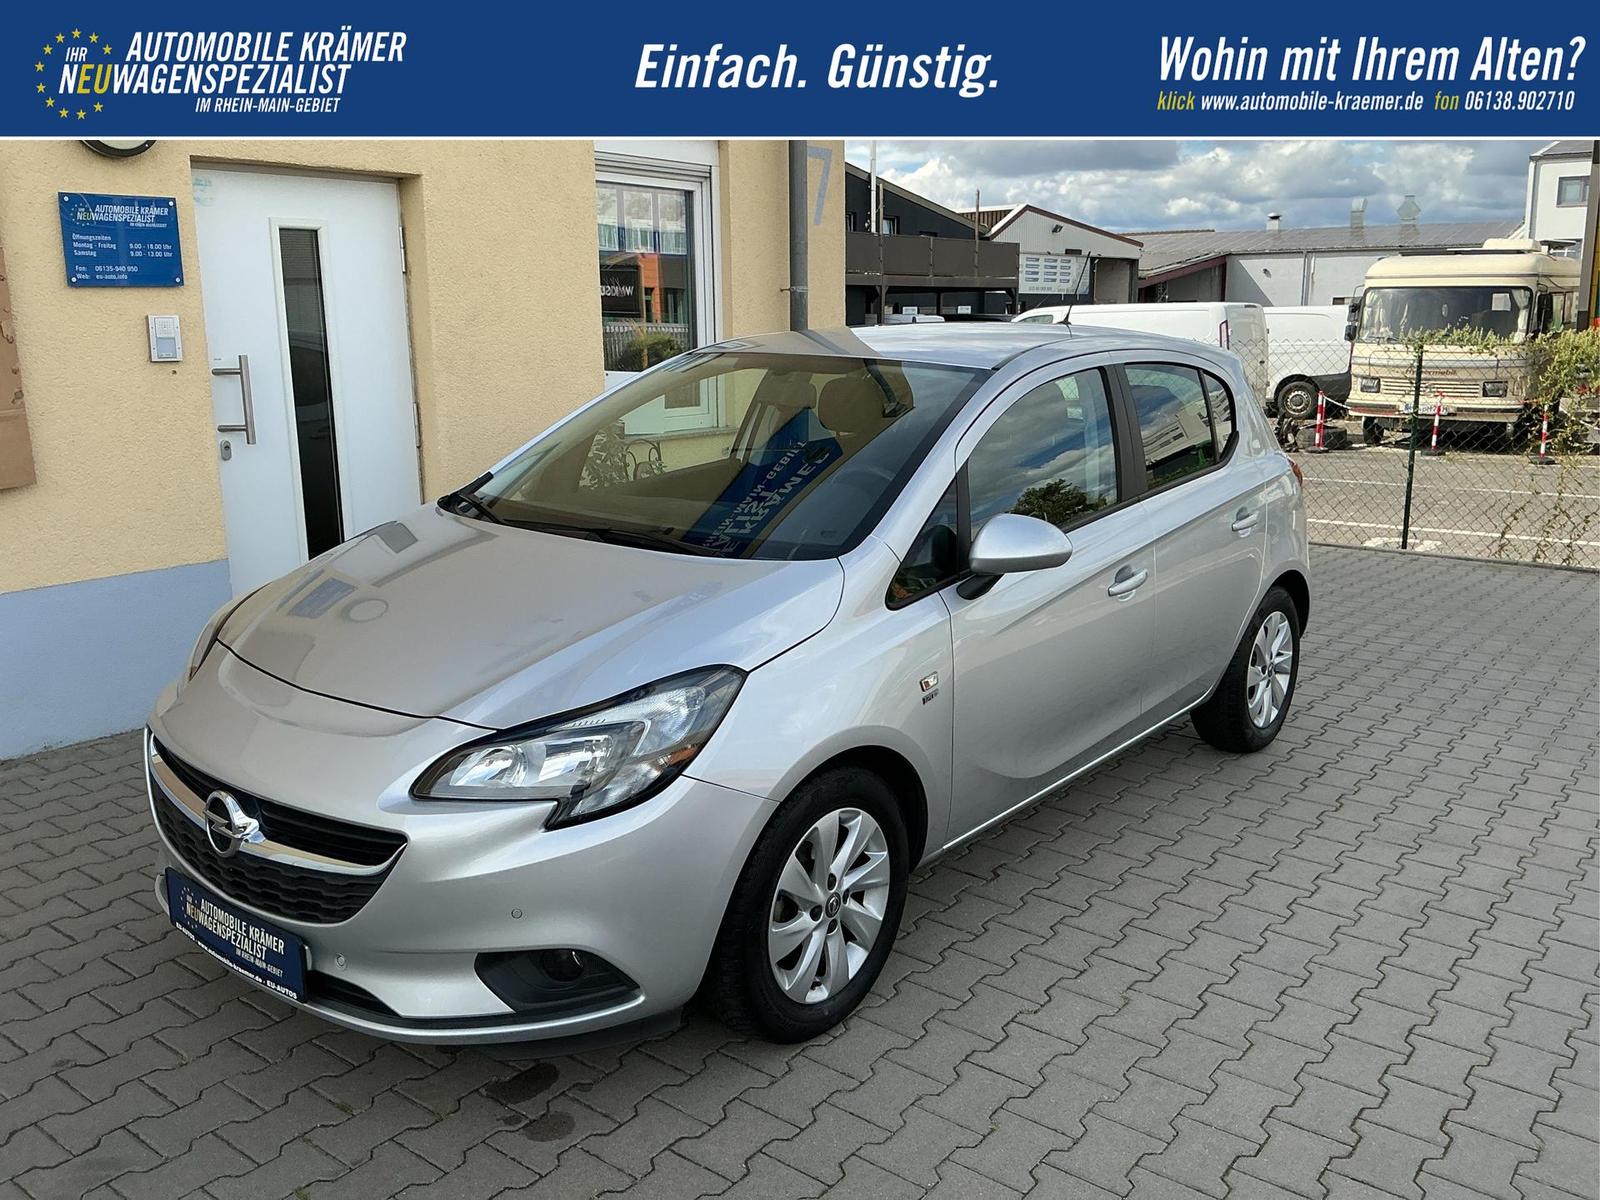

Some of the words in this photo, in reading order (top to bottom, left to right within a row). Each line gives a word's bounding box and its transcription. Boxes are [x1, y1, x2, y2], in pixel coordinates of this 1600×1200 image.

[95, 204, 140, 215] AUTOMOBILE
[76, 211, 155, 223] NEUWAGENSPEZIALIST
[73, 241, 93, 249] Montag
[98, 242, 117, 250] Freitag
[73, 249, 97, 257] Samstag
[186, 901, 267, 961] NEUWAGENSPEZIALIST
[200, 898, 247, 937] AUTOMOBILE
[249, 924, 285, 955] KRÄMER
[266, 979, 298, 1000] EU-AUTOS
